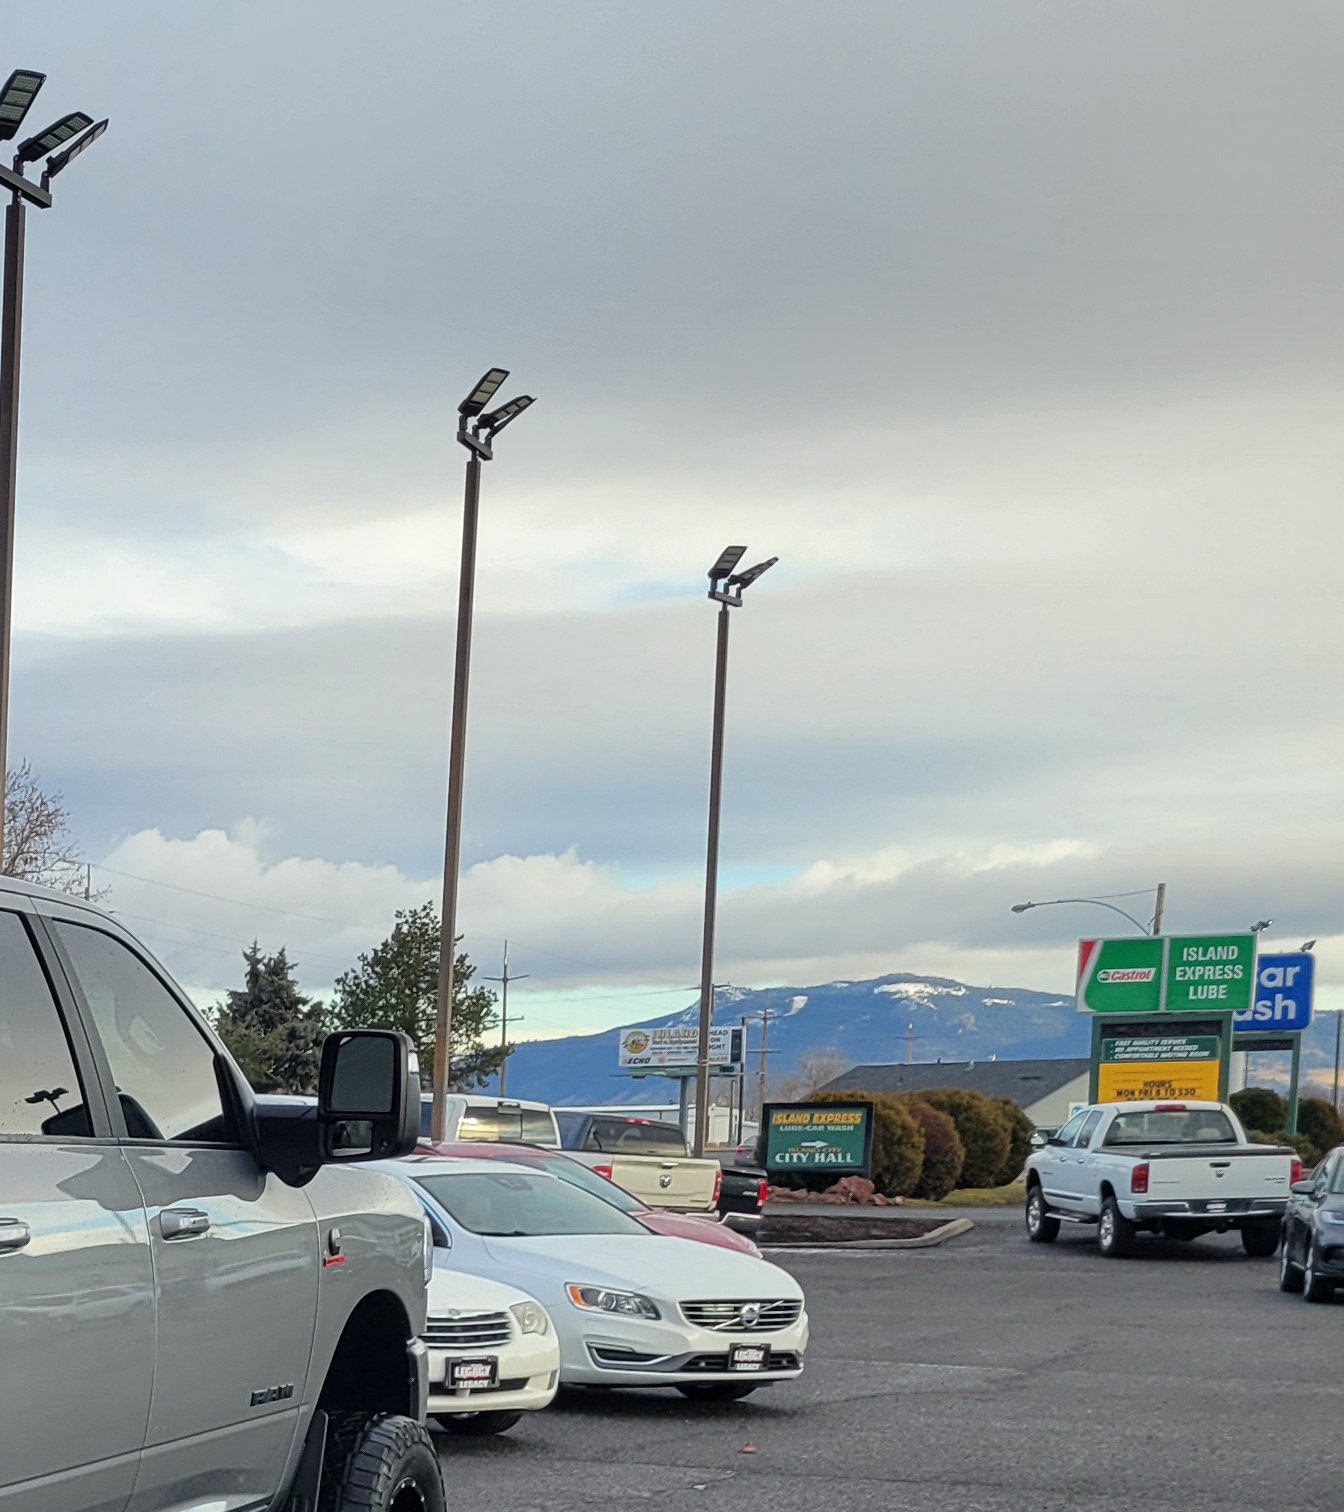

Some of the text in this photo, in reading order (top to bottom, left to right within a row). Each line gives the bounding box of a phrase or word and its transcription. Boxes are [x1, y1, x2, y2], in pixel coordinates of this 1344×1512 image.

[1183, 946, 1238, 961] ISLAND
[1111, 970, 1152, 981] Castrol
[1176, 965, 1243, 981] EXPRESS
[1257, 966, 1300, 988] ar
[1188, 985, 1228, 1000] LUBE
[1232, 993, 1296, 1021] ash
[1143, 1080, 1173, 1088] HOURS
[1116, 1089, 1135, 1097] MON
[1164, 1088, 1176, 1096] TO
[772, 1112, 862, 1124] ISLAND EXPRESS
[775, 1153, 854, 1163] CITY HALL
[250, 1384, 293, 1407] RAM
